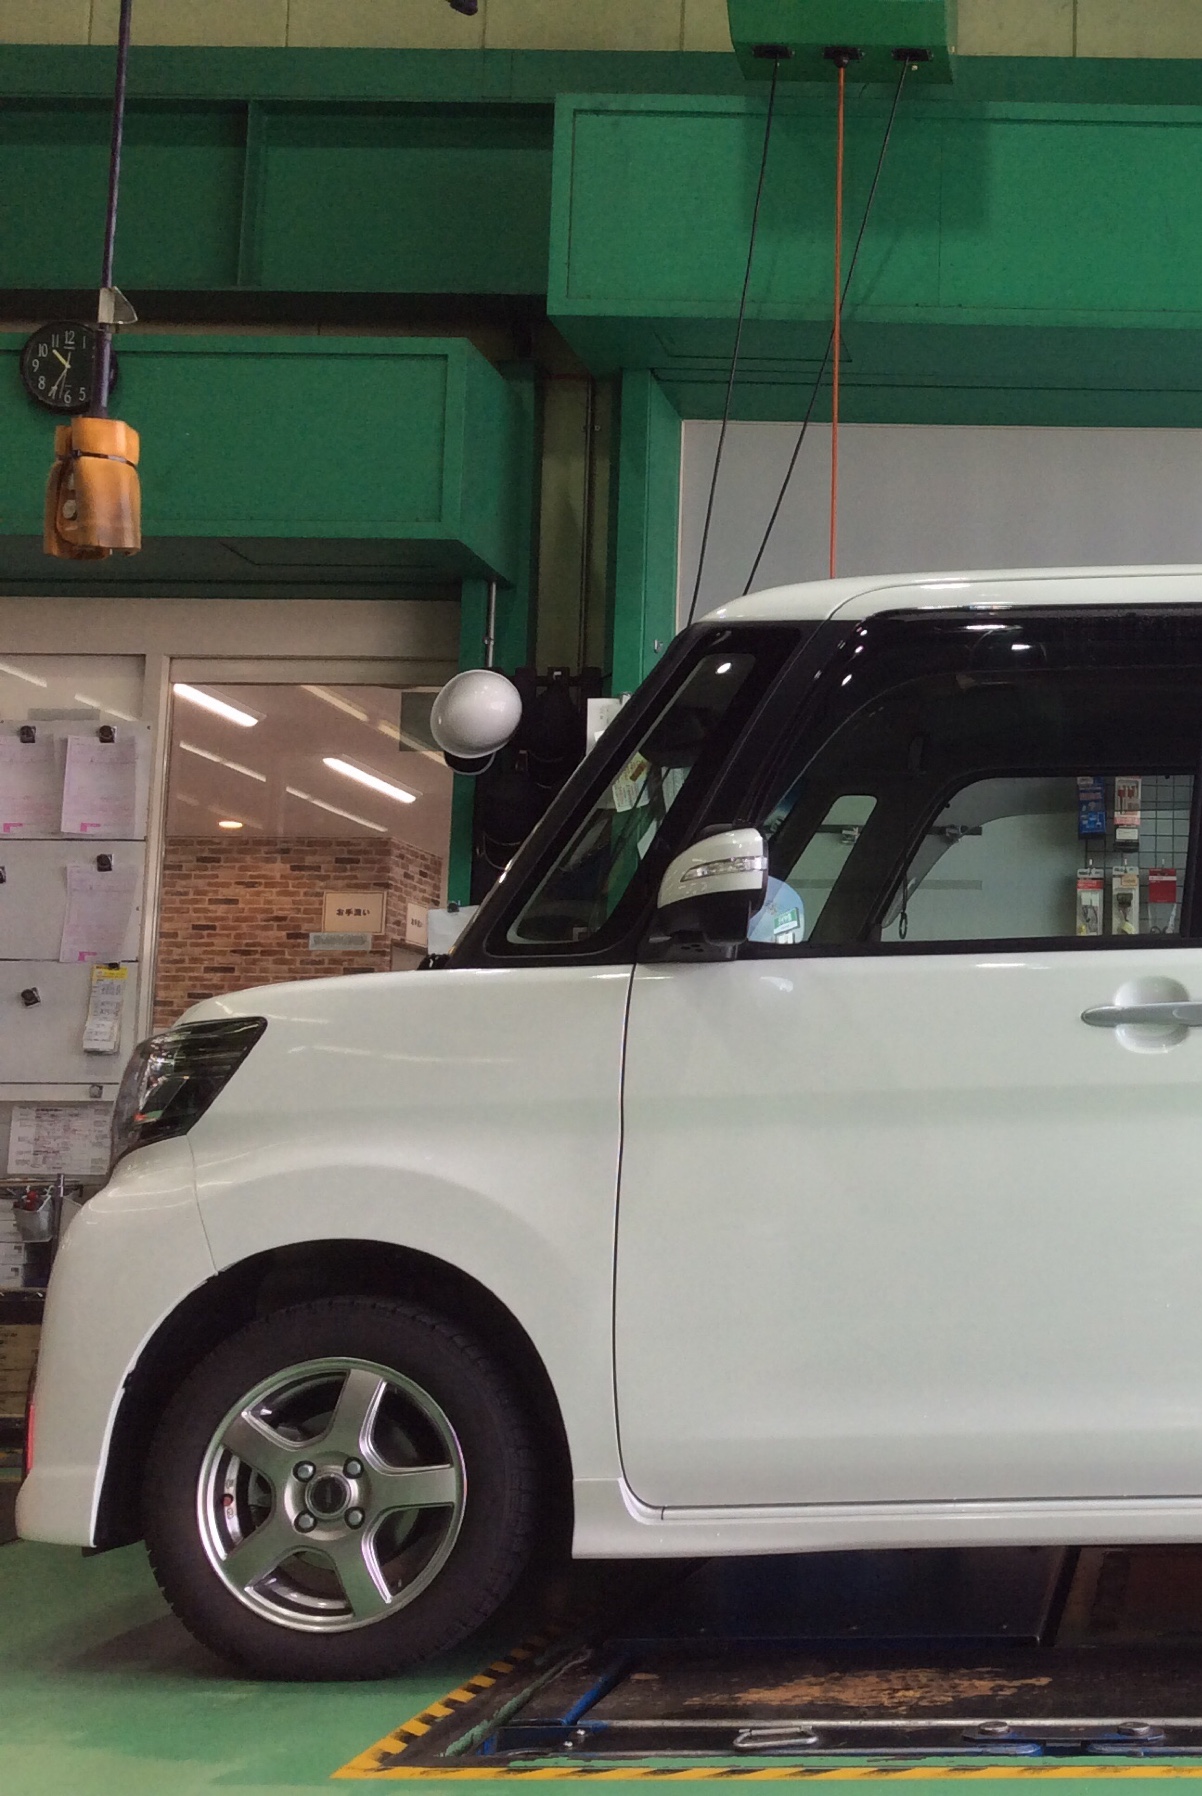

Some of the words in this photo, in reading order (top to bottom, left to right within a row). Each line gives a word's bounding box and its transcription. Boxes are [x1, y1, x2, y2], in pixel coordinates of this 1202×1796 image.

[51, 334, 59, 348] 11
[65, 330, 75, 345] 12
[38, 343, 49, 358] 10
[32, 359, 39, 372] 9
[38, 375, 46, 390] 8
[64, 389, 72, 404] 6
[79, 387, 86, 402] 5
